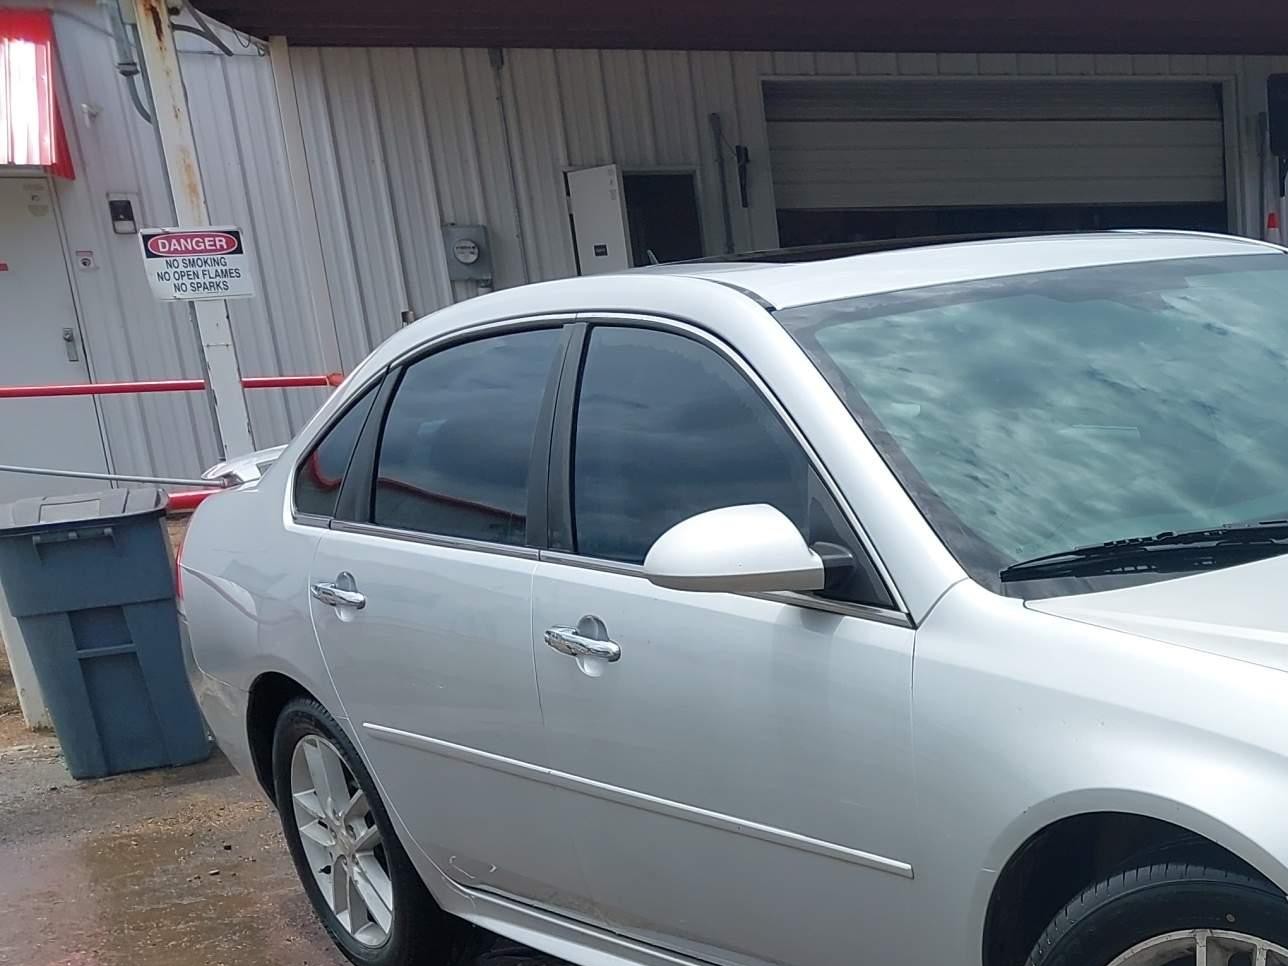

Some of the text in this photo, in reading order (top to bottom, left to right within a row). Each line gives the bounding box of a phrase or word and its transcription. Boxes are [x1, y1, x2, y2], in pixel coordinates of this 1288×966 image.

[157, 237, 227, 252] DANGER
[165, 256, 228, 270] NO SMOKING
[156, 268, 241, 282] NO OPEN FLAMES
[173, 280, 229, 293] NO SPARKS
